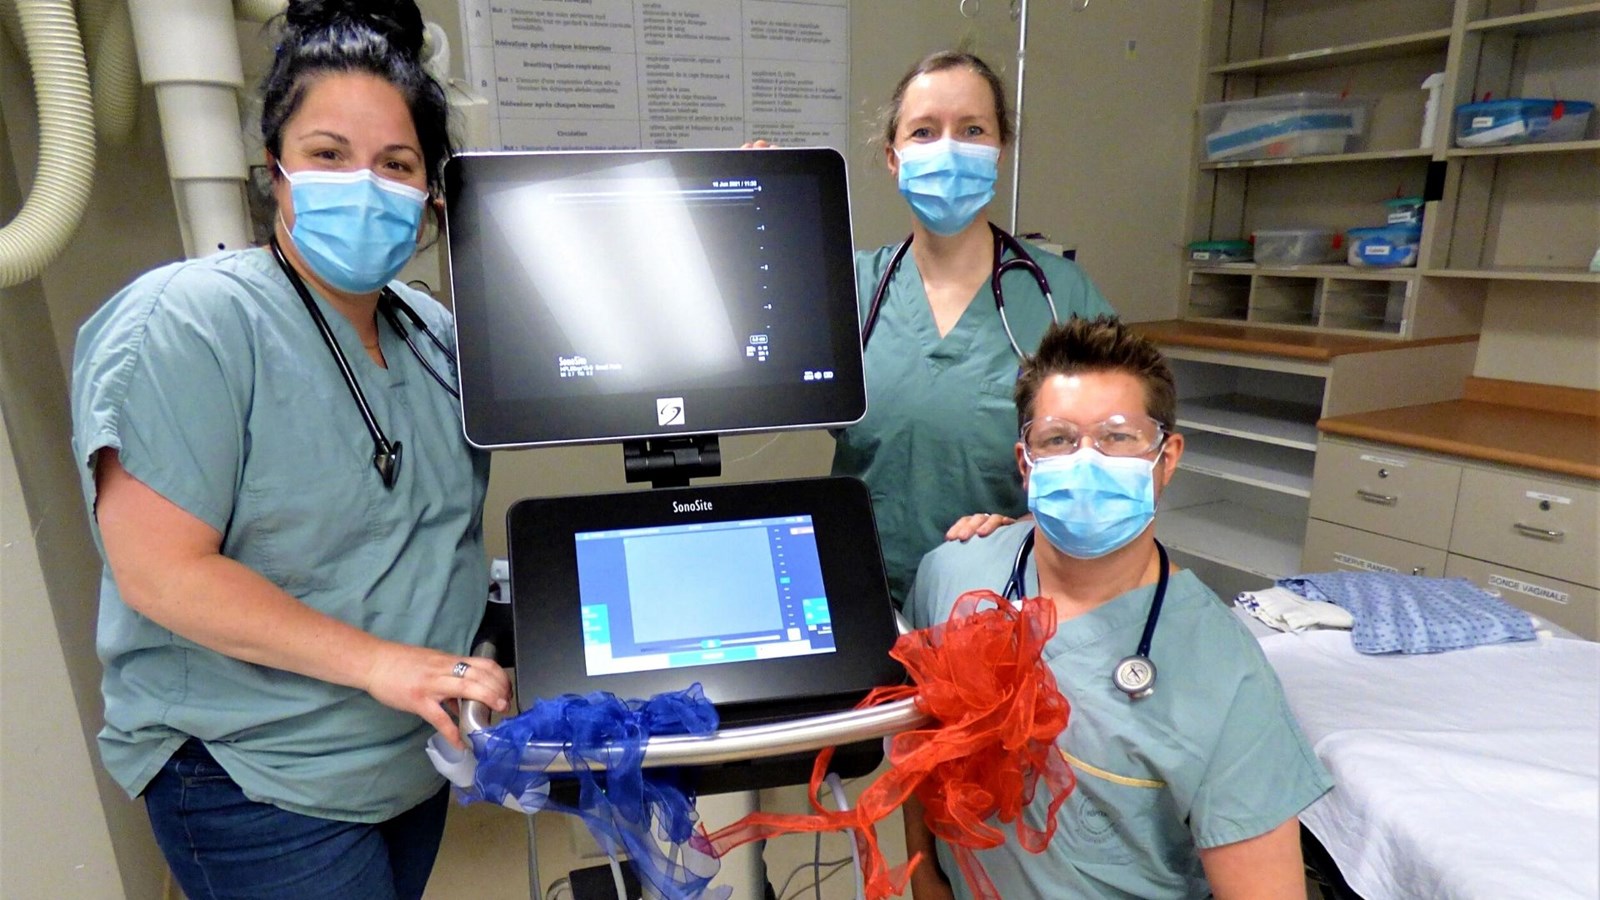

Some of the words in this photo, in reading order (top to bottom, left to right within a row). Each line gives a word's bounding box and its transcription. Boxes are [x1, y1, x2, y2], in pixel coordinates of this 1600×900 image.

[672, 499, 713, 513] SonoSite
[1490, 575, 1520, 591] SONDE
[1522, 584, 1568, 602] VAGINALE
